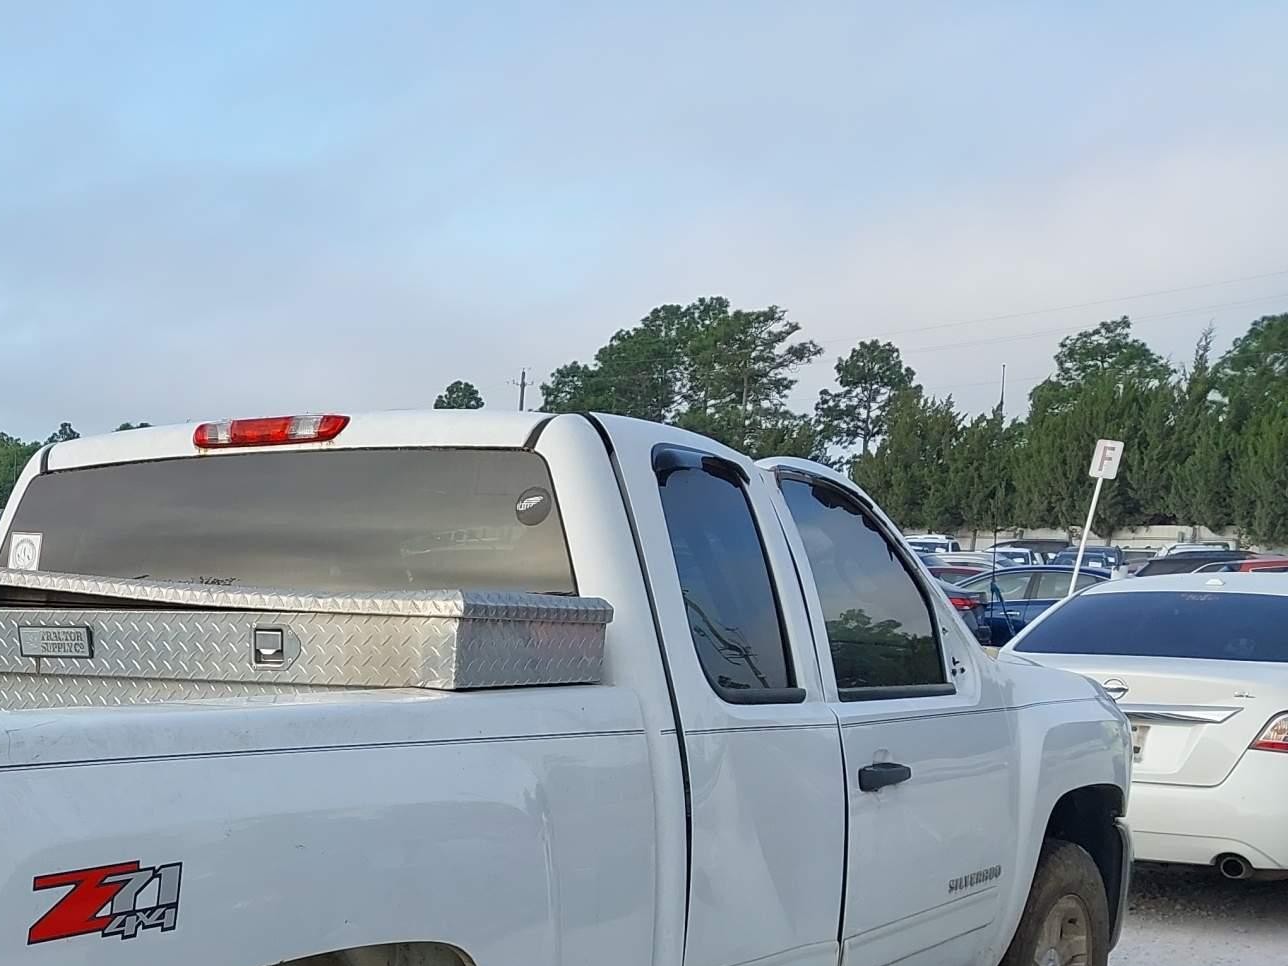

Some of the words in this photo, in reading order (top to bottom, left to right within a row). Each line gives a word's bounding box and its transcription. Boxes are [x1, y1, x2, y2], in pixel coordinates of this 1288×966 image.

[1098, 446, 1116, 471] F
[40, 630, 83, 642] TRACTOR
[41, 642, 73, 653] SUPPLY
[948, 864, 1002, 894] SILVERADO
[27, 860, 183, 945] Z71
